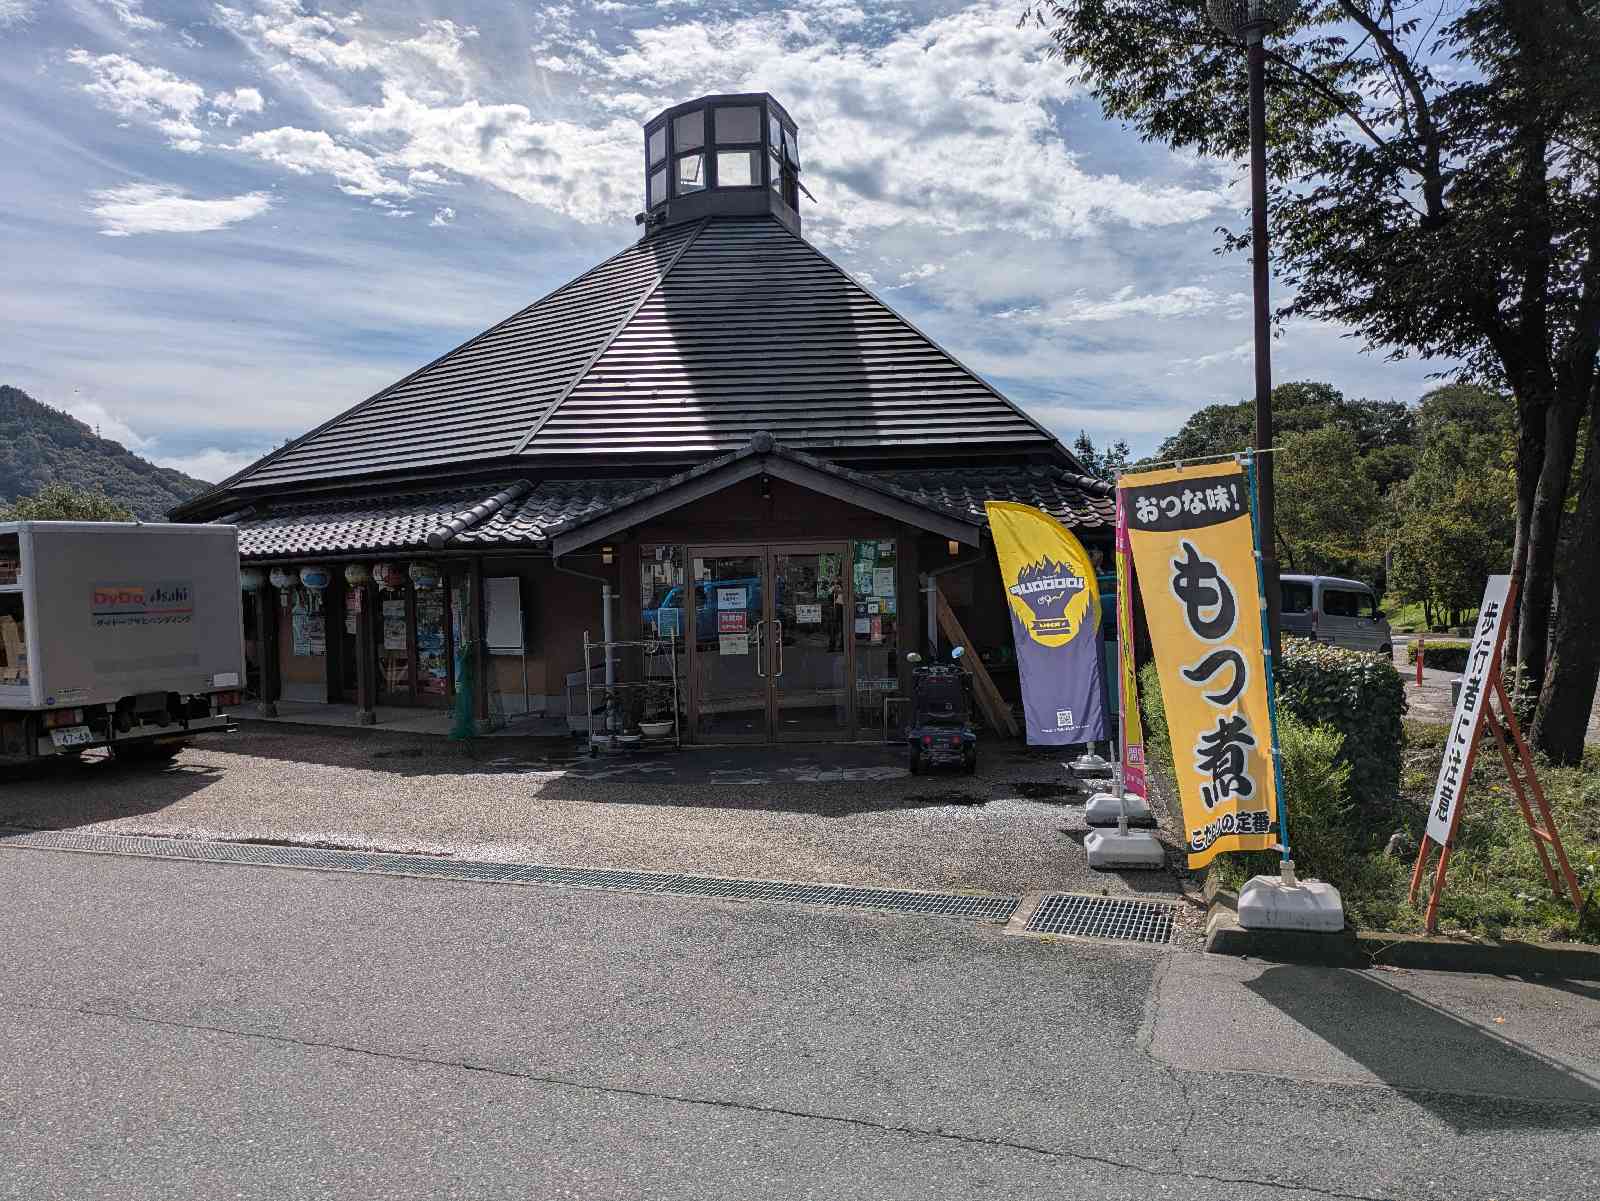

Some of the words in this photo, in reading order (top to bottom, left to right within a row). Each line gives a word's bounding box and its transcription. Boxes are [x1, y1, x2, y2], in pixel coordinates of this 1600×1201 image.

[1135, 483, 1240, 523] おつな味!
[150, 587, 188, 604] Asahi
[1172, 541, 1256, 809] もつ煮
[1434, 601, 1499, 824] 歩行者に注意
